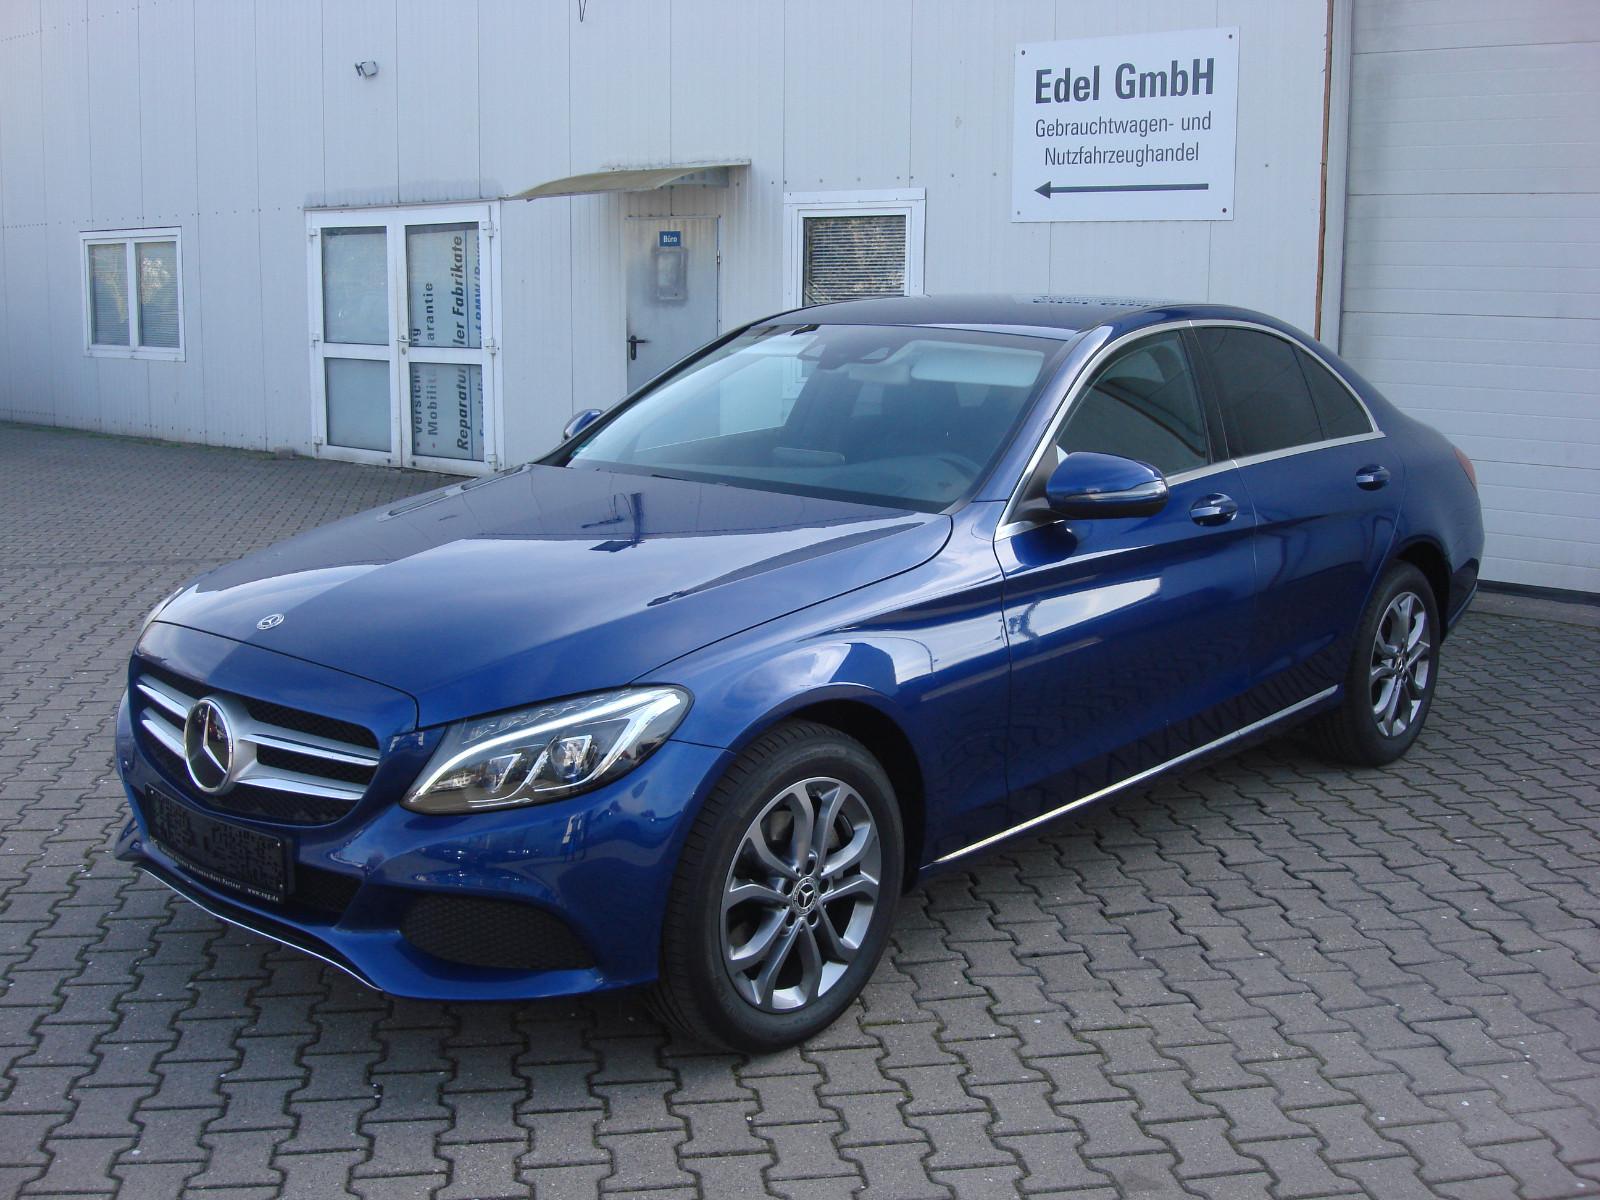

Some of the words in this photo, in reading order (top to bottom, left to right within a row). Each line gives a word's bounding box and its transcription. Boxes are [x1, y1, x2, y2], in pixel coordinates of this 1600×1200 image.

[1036, 65, 1100, 104] Edel
[1115, 57, 1214, 99] GmbH
[1035, 116, 1174, 138] Gebrauchtwagen-
[1181, 110, 1212, 131] und
[1045, 142, 1200, 167] Nutzfahrzeughandel
[450, 235, 464, 316] Fabrikate
